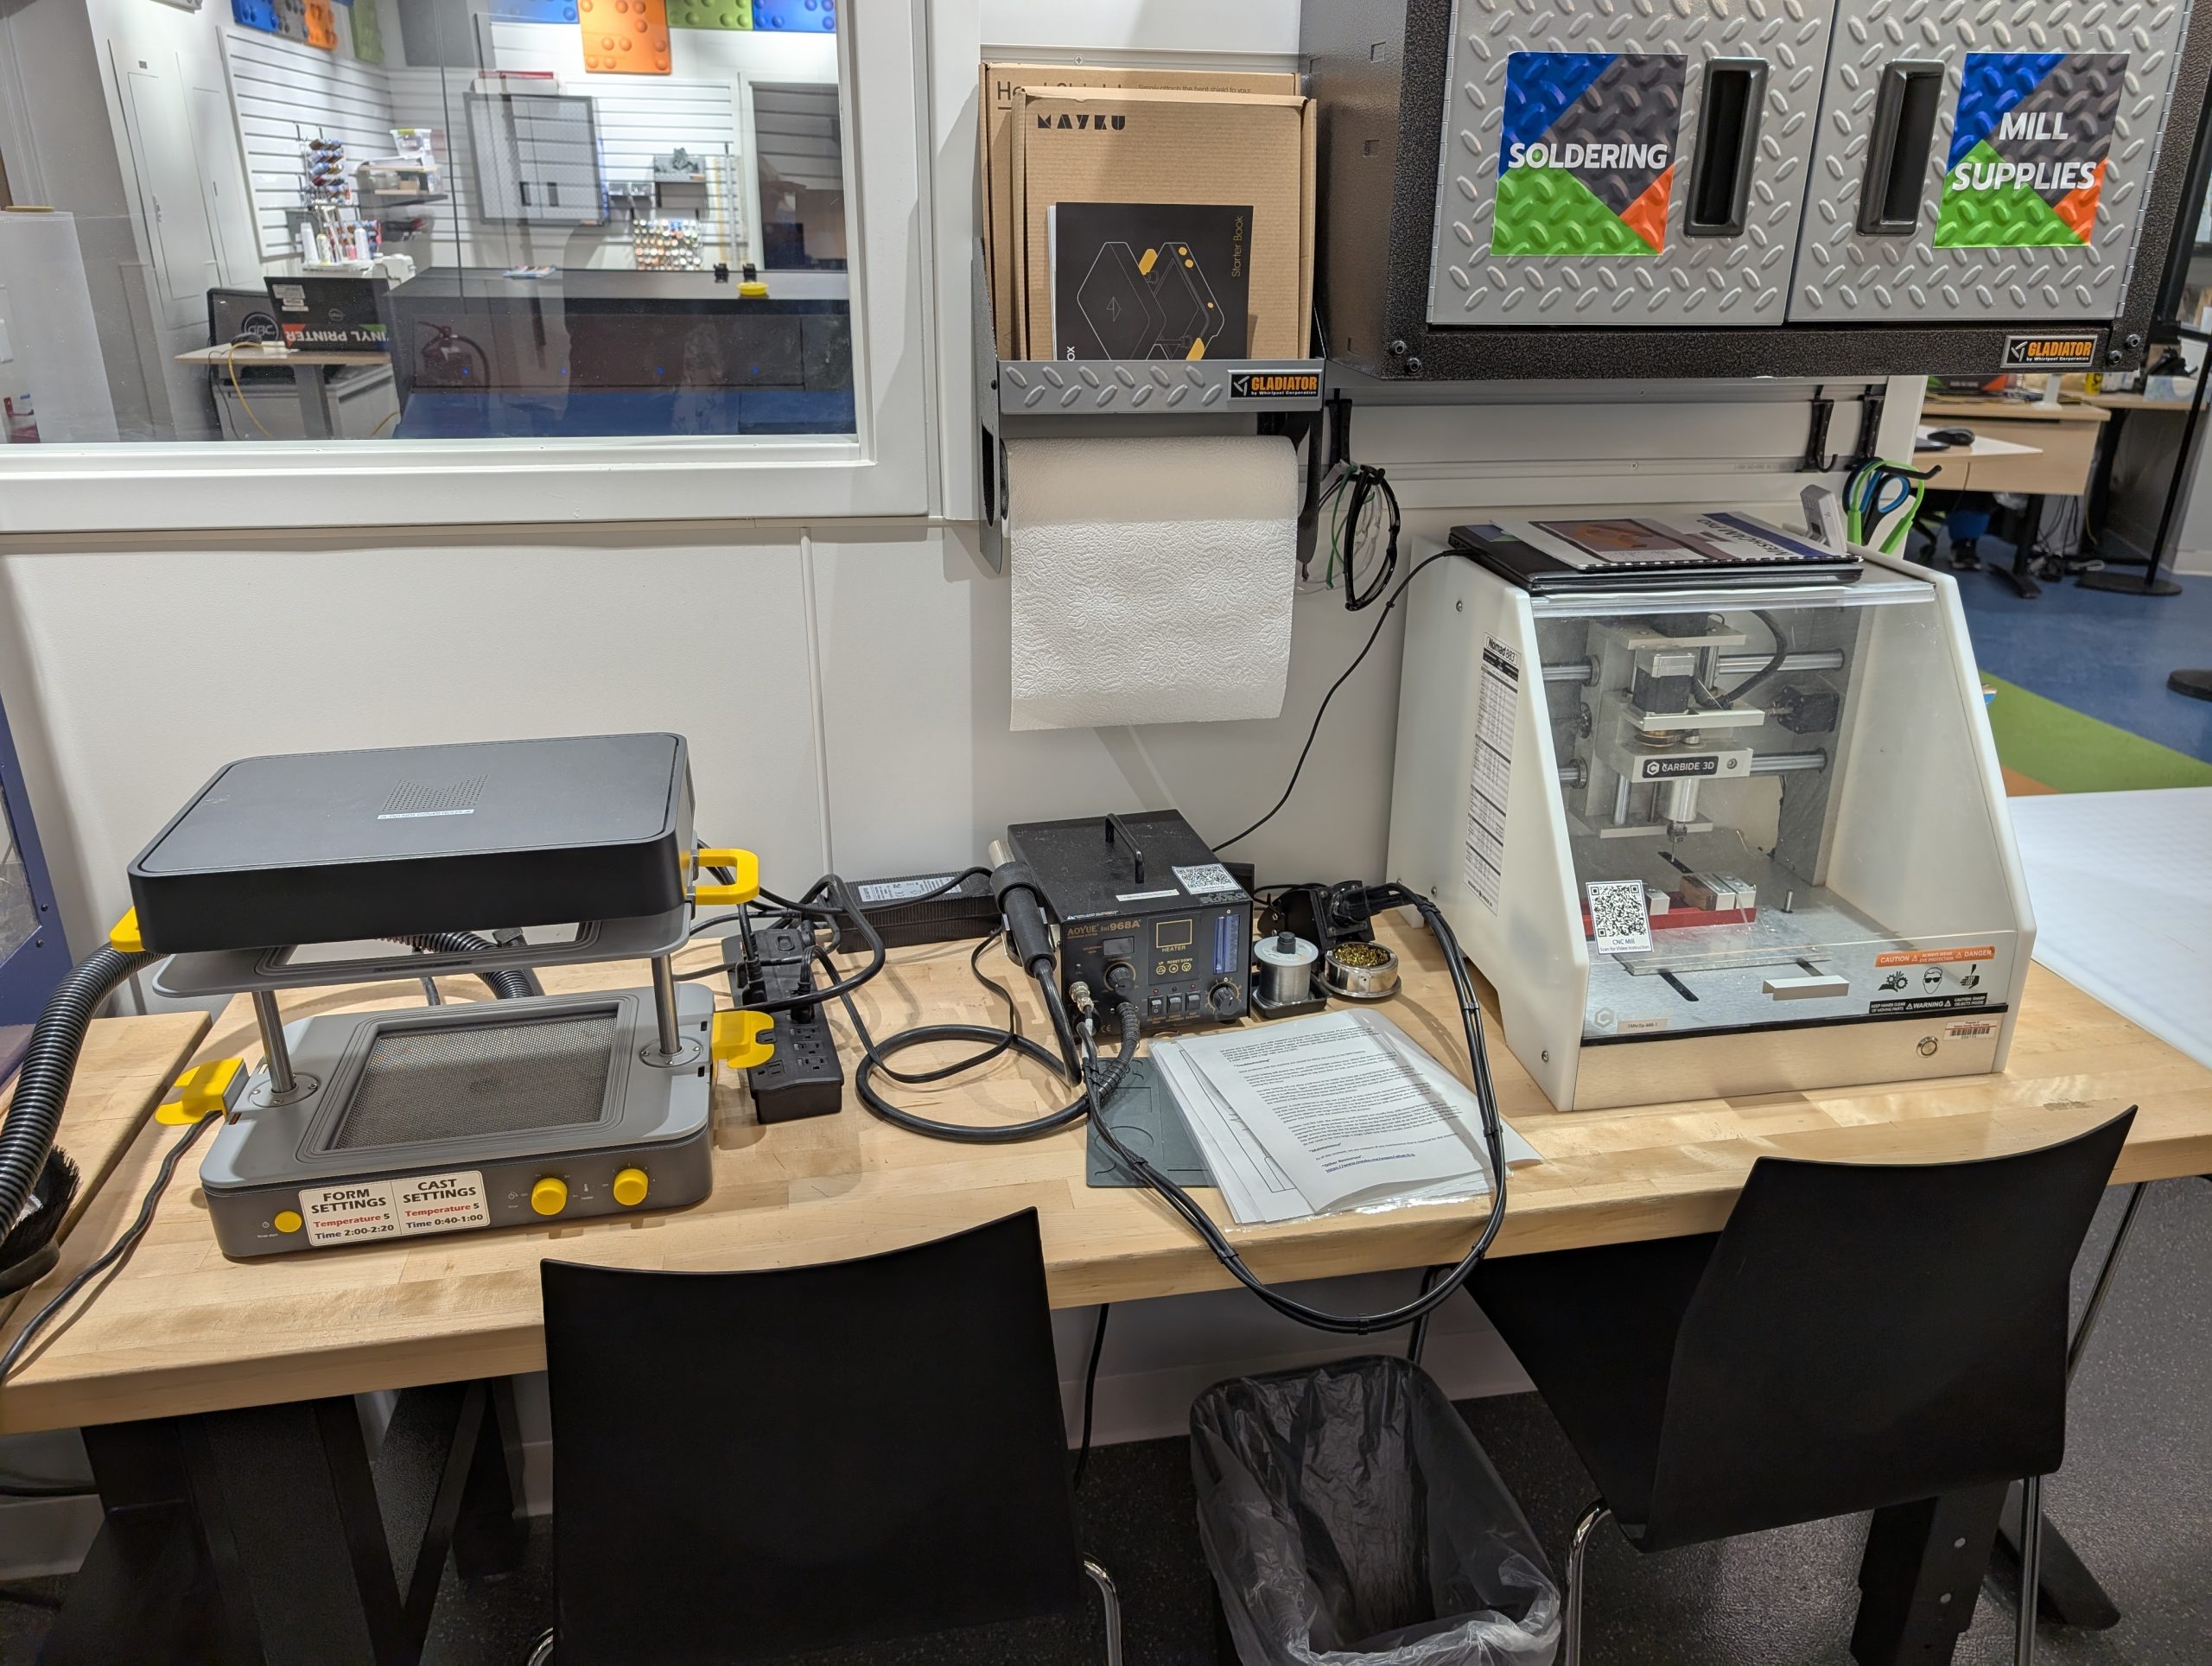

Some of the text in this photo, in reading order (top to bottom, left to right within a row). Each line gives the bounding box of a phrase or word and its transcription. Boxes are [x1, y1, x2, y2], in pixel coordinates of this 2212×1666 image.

[1037, 113, 1126, 130] MAYKU
[1999, 111, 2069, 141] MILL
[1508, 142, 1668, 169] SOLDERING
[1952, 161, 2097, 191] SUPPLIES
[1231, 215, 1244, 277] Starter Book
[285, 330, 389, 343] INYL PRINTER
[2027, 341, 2092, 357] GLADIATOR
[1251, 376, 1318, 391] GLADIATOR
[1487, 639, 1506, 657] Nomad
[1662, 761, 1700, 773] CARBIDE
[1702, 761, 1714, 770] 3D
[1067, 925, 1098, 936] AOYUE
[1880, 955, 1910, 963] CAUTION
[1964, 949, 1993, 957] DANGER
[1913, 1001, 1944, 1009] WARNING
[418, 1179, 457, 1192] CAST
[323, 1188, 370, 1202] FORM
[403, 1186, 476, 1204] SETTINGS
[311, 1197, 387, 1214] SETTINGS
[404, 1204, 471, 1218] Temperature
[313, 1215, 381, 1229] Temperature
[405, 1213, 484, 1230] Time 0:40-1:00
[315, 1224, 394, 1240] Time 2:00-2:20
